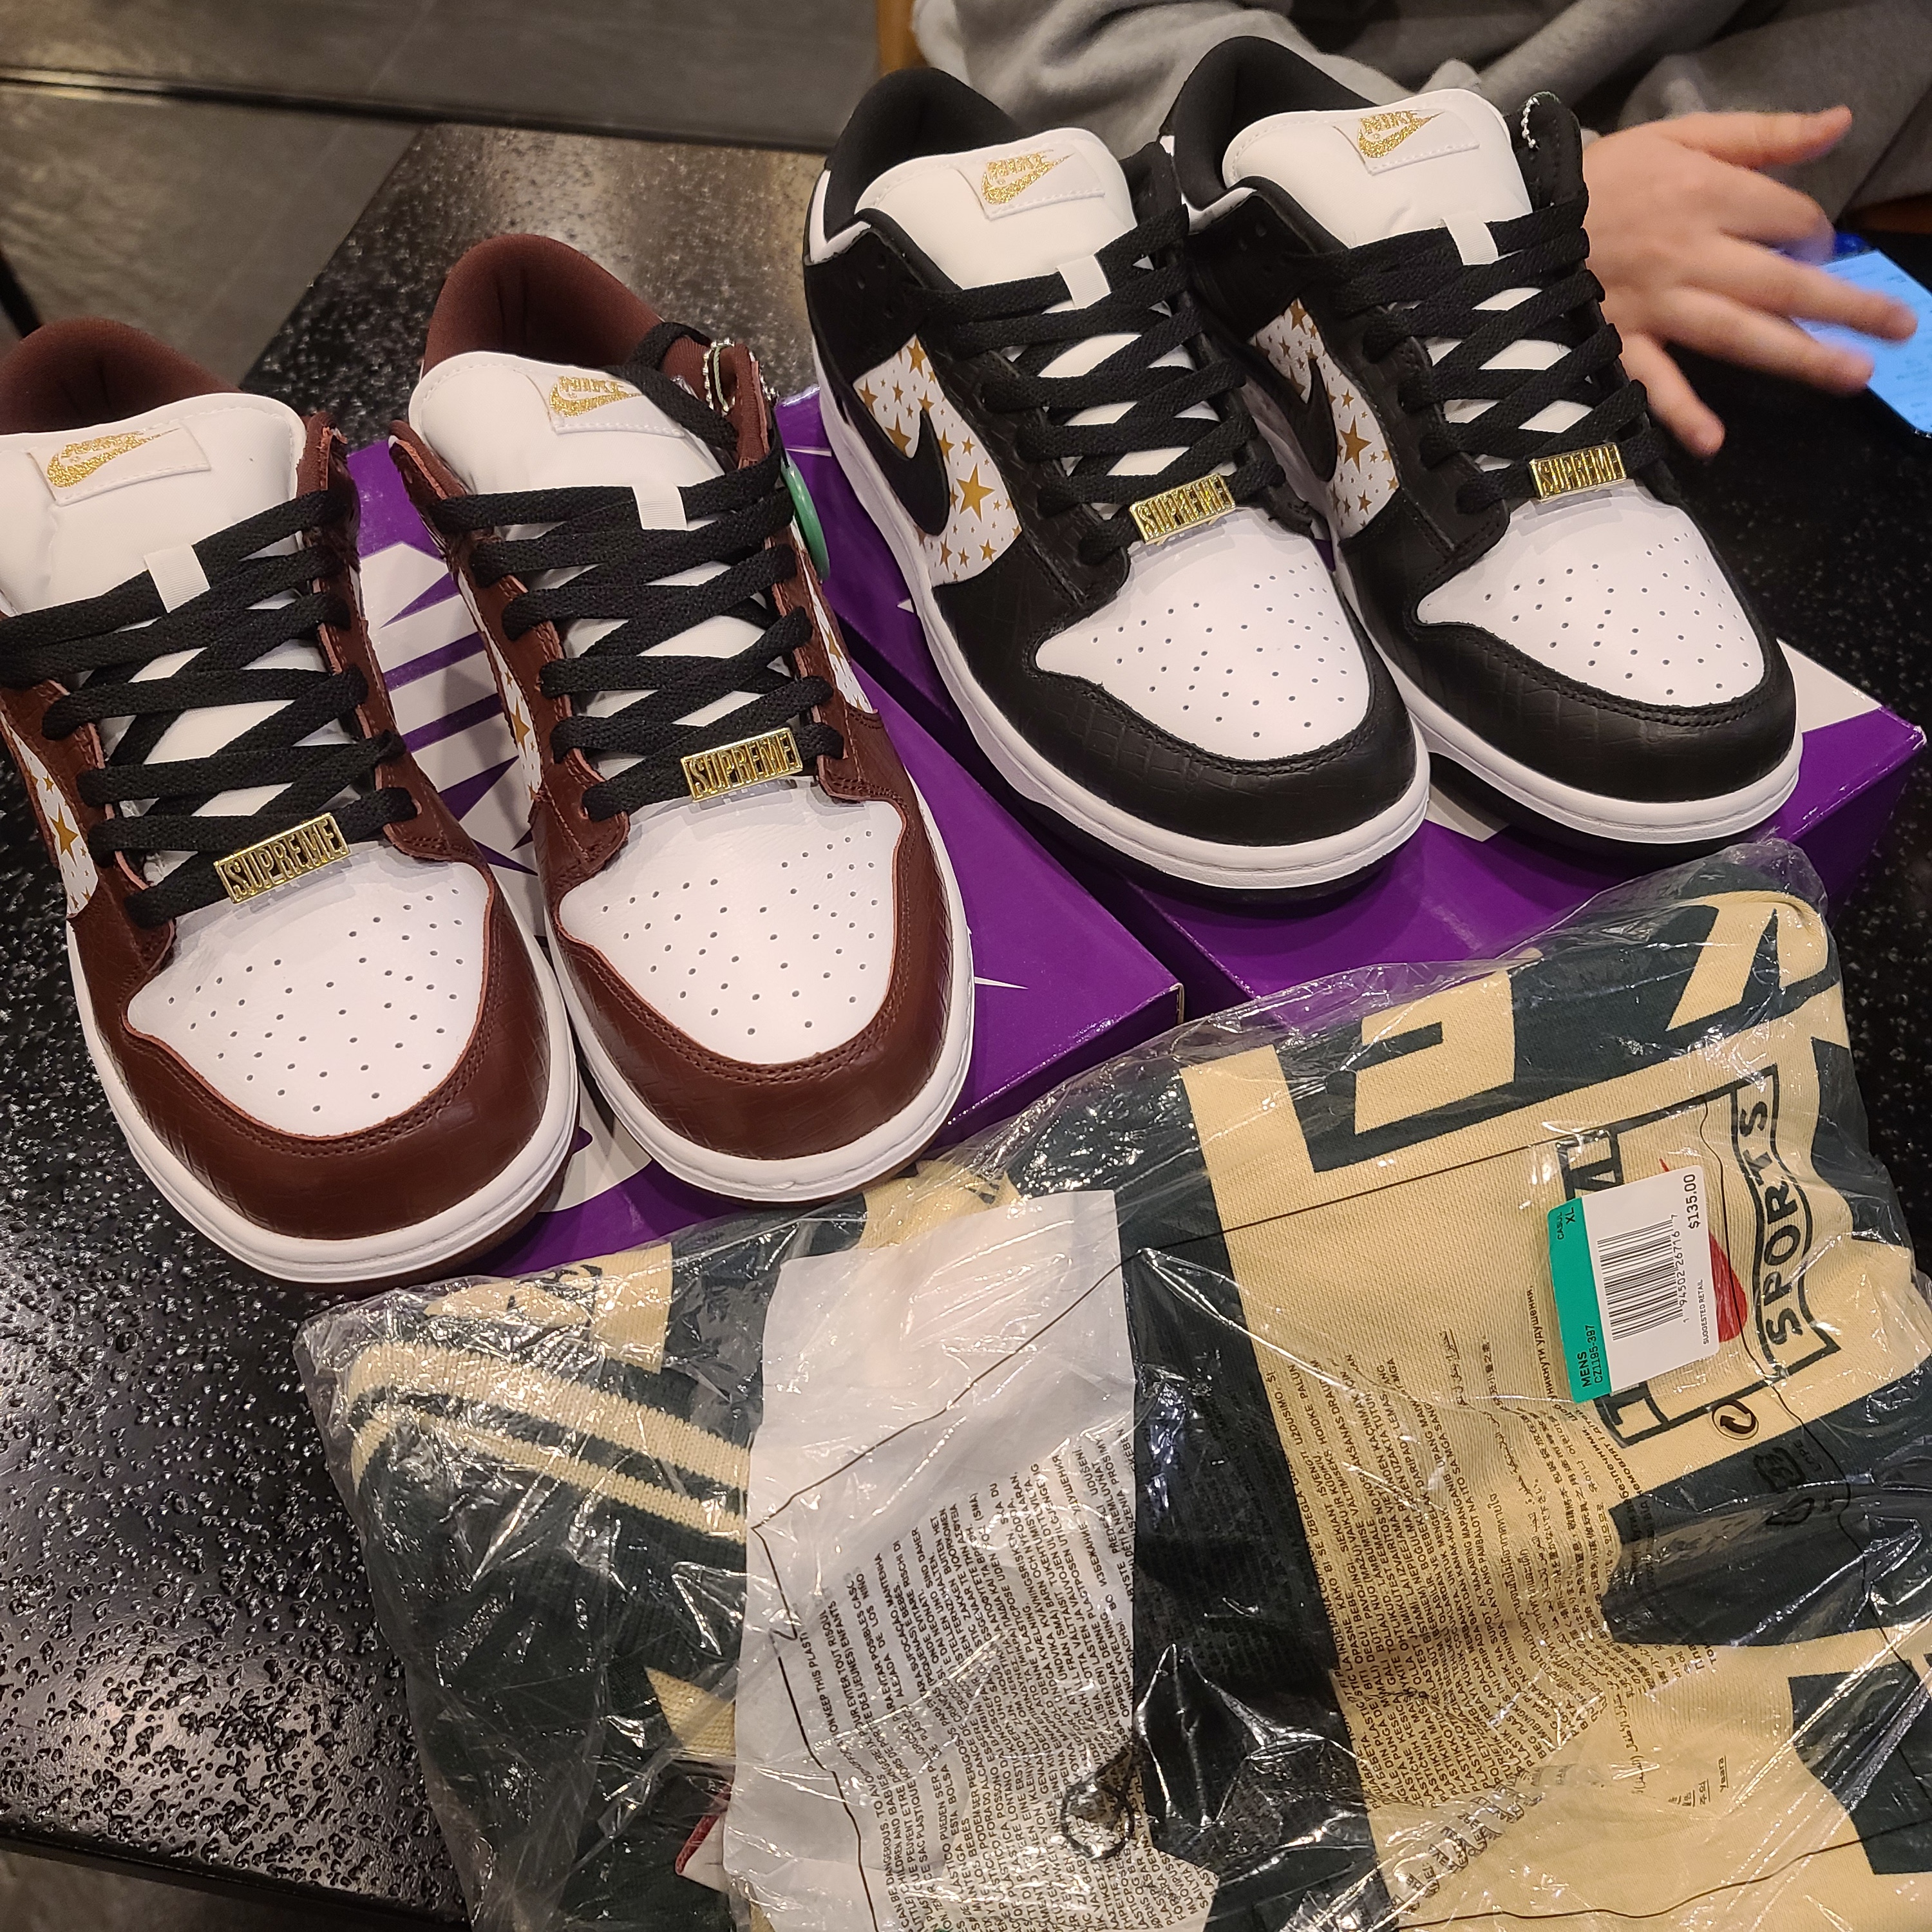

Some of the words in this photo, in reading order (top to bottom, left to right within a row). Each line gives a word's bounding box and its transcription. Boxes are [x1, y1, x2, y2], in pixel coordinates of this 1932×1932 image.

[1359, 109, 1418, 136] NIKE
[987, 149, 1054, 181] NIKE
[1537, 444, 1624, 497] SUPREME
[1137, 474, 1233, 538] SUPREME
[687, 732, 801, 798] SUPREME
[225, 818, 348, 899] SUPREME
[1564, 1207, 1575, 1223] XL
[1682, 1173, 1701, 1228] $135.00
[1739, 1101, 1802, 1345] SPORTS
[1671, 1231, 1684, 1266] 26716
[1676, 1270, 1688, 1305] 94502
[1696, 1279, 1705, 1302] RETAIL
[1288, 1363, 1309, 1399] PALUN
[1576, 1350, 1593, 1387] MENS
[1305, 1403, 1327, 1446] HOIDKE
[1379, 1429, 1402, 1475] UZAKTA
[989, 1482, 1000, 1497] DU
[929, 1515, 942, 1535] HET
[1116, 1527, 1126, 1537] A
[1325, 1502, 1349, 1553] SIEKIANT
[891, 1540, 902, 1551] DI
[910, 1527, 927, 1562] DAHER
[934, 1538, 952, 1573] BUITEN
[960, 1544, 974, 1566] ΤΗΝ
[1079, 1521, 1108, 1587] ИЗБЕЖАНИЕ
[1315, 1540, 1326, 1556] SE
[894, 1553, 911, 1586] RISCHI
[920, 1564, 934, 1587] SIND
[957, 1571, 969, 1586] TE
[989, 1552, 1005, 1582] UDEN
[1026, 1554, 1041, 1579] OCH
[1050, 1550, 1078, 1608] VAUVOJEN
[1322, 1560, 1332, 1573] BI
[928, 1590, 943, 1613] UND
[948, 1578, 971, 1620] ZAKKEN
[1037, 1579, 1054, 1608] BARN
[1104, 1593, 1117, 1611] ВО
[1329, 1577, 1345, 1609] KAKO
[1384, 1566, 1412, 1626] IMIKUTEST
[865, 1604, 879, 1627] LOS
[906, 1589, 927, 1633] EVITARE
[1001, 1584, 1034, 1653] PLASTICPOSE
[1047, 1609, 1067, 1640] (SMÅ)
[1072, 1607, 1084, 1624] JA
[1482, 1611, 1499, 1643] SUPOT
[855, 1610, 878, 1660] POSIBLES
[874, 1632, 886, 1648] DE
[934, 1636, 947, 1656] DAI
[1021, 1602, 1048, 1661] KVÆLNING.
[1078, 1624, 1100, 1665] LASTEN
[1091, 1621, 1110, 1658] DENNE
[1098, 1607, 1124, 1665] KVELNING.
[1358, 1630, 1376, 1663] DECU
[1375, 1611, 1396, 1654] TOLIAU
[830, 1649, 846, 1674] TOUT
[906, 1625, 936, 1687] (PEQUENAS)
[922, 1634, 939, 1664] ONDE
[1045, 1632, 1068, 1681] UNDVIKA
[1057, 1641, 1076, 1671] FRÅN
[811, 1669, 825, 1690] THIS
[843, 1647, 866, 1691] (JEUNES)
[1028, 1657, 1048, 1696] DENNE
[1381, 1659, 1396, 1686] GALI
[1405, 1656, 1421, 1685] OLLA
[1471, 1656, 1495, 1700] ADALAH
[839, 1675, 856, 1707] EVITER
[858, 1691, 871, 1710] DES
[1092, 1665, 1119, 1719] (PIENTEN)
[1105, 1660, 1131, 1718] OPPBEVAR
[819, 1693, 833, 1718] KEEP
[970, 1718, 995, 1763] ESSERE
[974, 1701, 1000, 1748] BAMBINI
[967, 1738, 990, 1790] ALCANCE
[1380, 1748, 1394, 1768] DIN
[877, 1774, 897, 1815] BABIES
[931, 1774, 944, 1798] SER
[940, 1763, 957, 1803] BOLSA
[990, 1766, 1007, 1817] POSSONO
[1002, 1770, 1019, 1821] LONTANO
[873, 1799, 885, 1817] TO
[907, 1780, 924, 1837] PLASTIQUE
[937, 1800, 949, 1839] PUEDEN
[949, 1810, 961, 1834] ESTA
[983, 1806, 998, 1837] FORA
[1018, 1793, 1032, 1821] EINE
[1033, 1807, 1048, 1833] VON
[891, 1817, 902, 1839] AND
[905, 1819, 914, 1861] PEUVENT
[959, 1817, 978, 1857] BEBÉS
[917, 1839, 929, 1861] SAC
[922, 1864, 933, 1880] CE
[972, 1859, 985, 1884] LOS
[888, 1886, 900, 1902] BE
[894, 1904, 909, 1928] CAN
